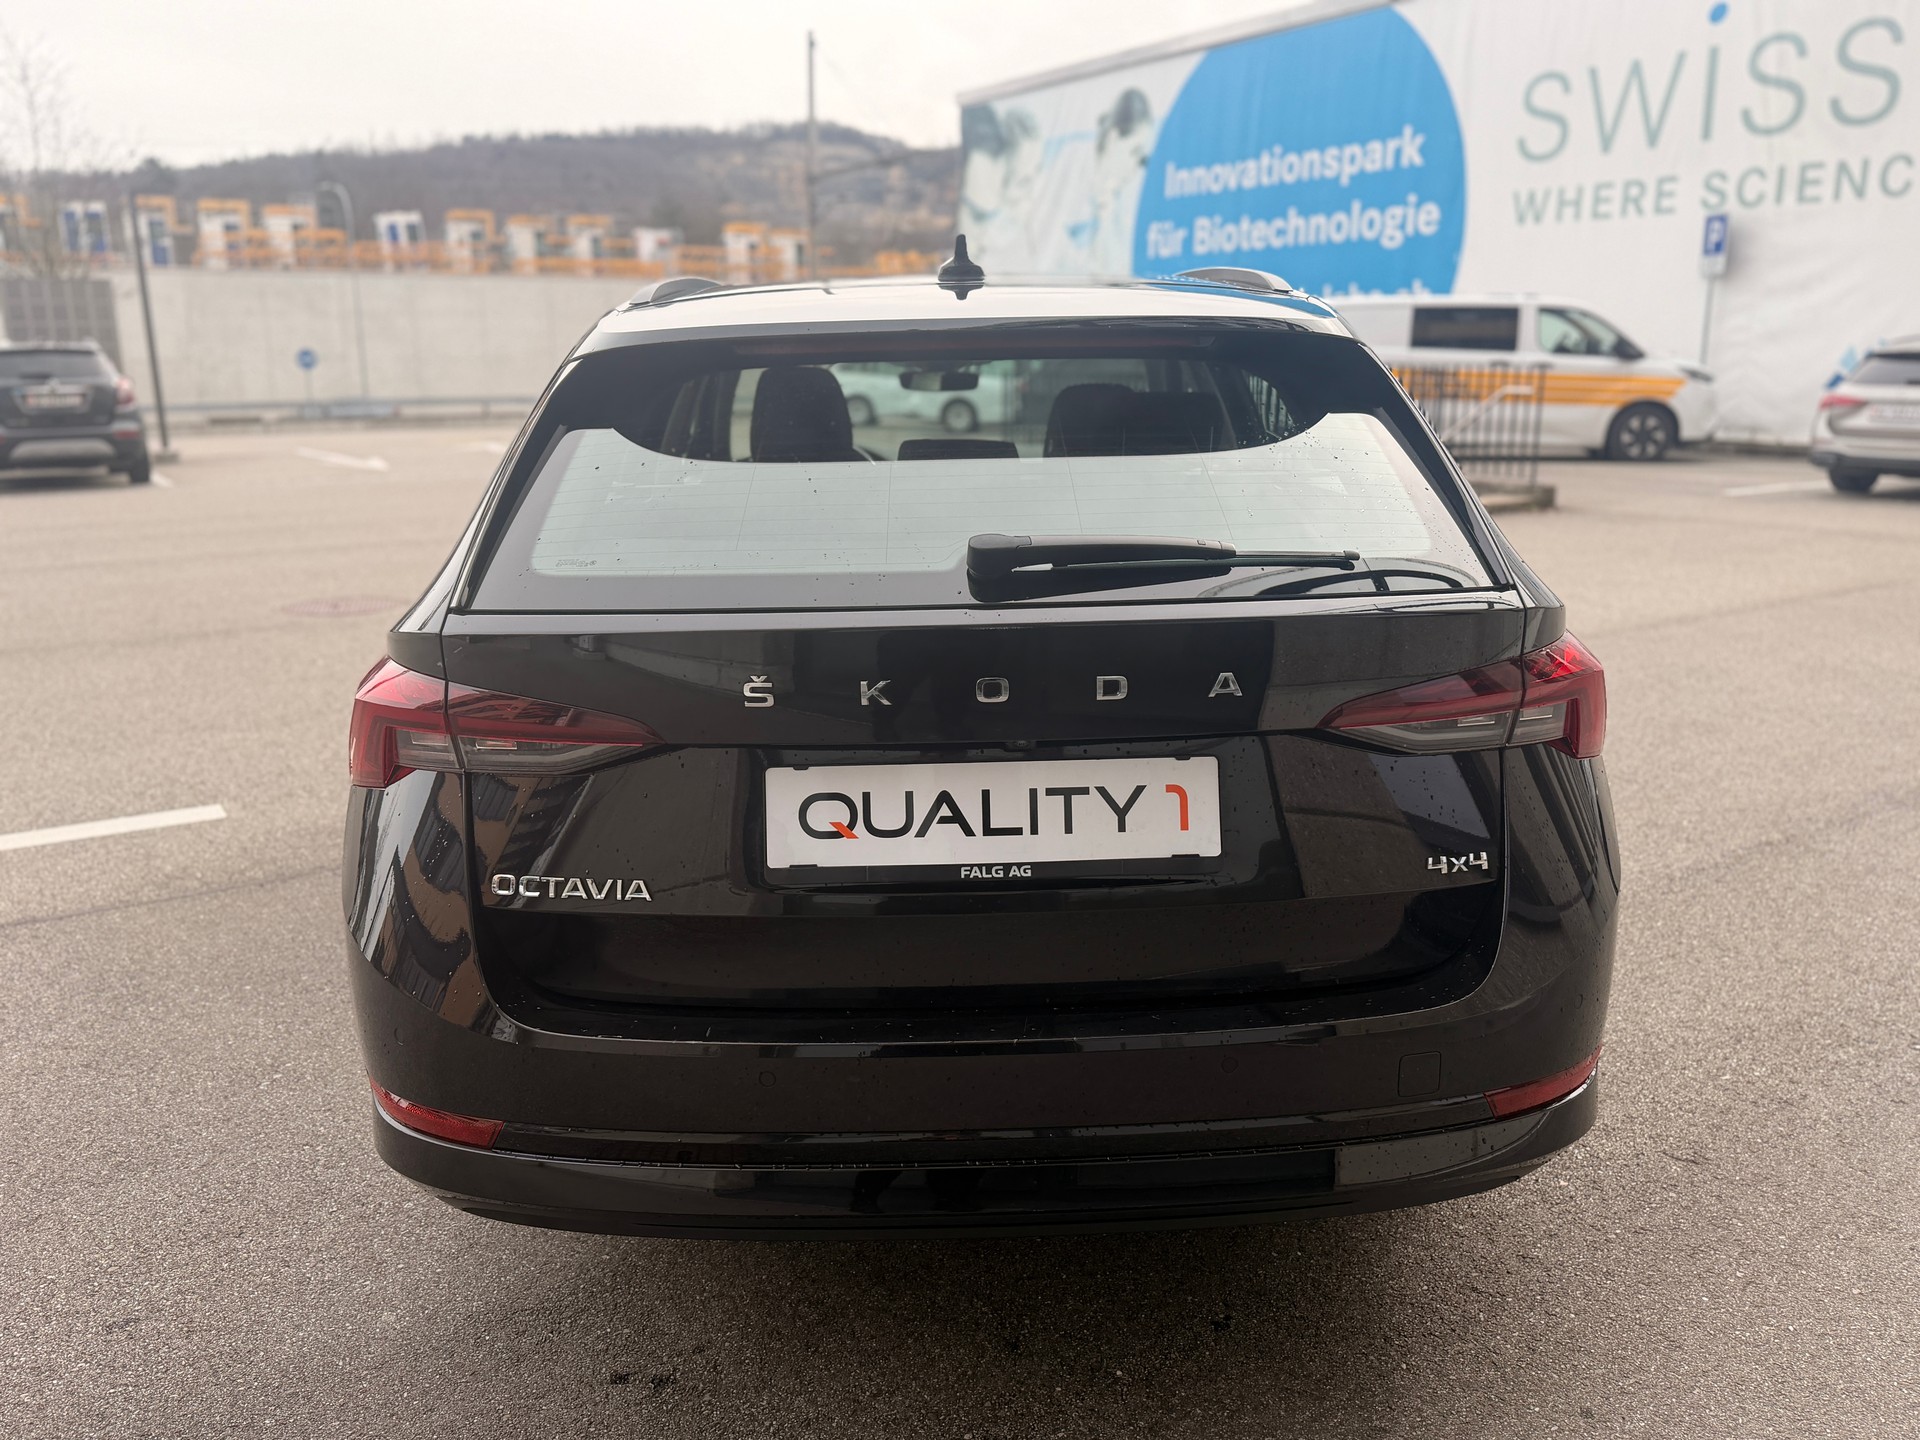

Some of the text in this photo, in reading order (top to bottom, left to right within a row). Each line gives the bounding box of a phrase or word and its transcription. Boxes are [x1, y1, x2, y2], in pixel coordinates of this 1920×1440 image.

[1164, 125, 1425, 199] Innovationspark
[1513, 176, 1680, 225] WHERE
[1147, 193, 1441, 260] für Biotechnologie
[743, 672, 1243, 707] ŠKODA
[798, 782, 1190, 840] QUALITY 1
[960, 865, 1032, 879] FALG AG
[1427, 851, 1489, 874] 4x4
[491, 873, 652, 901] OCTAVIA
